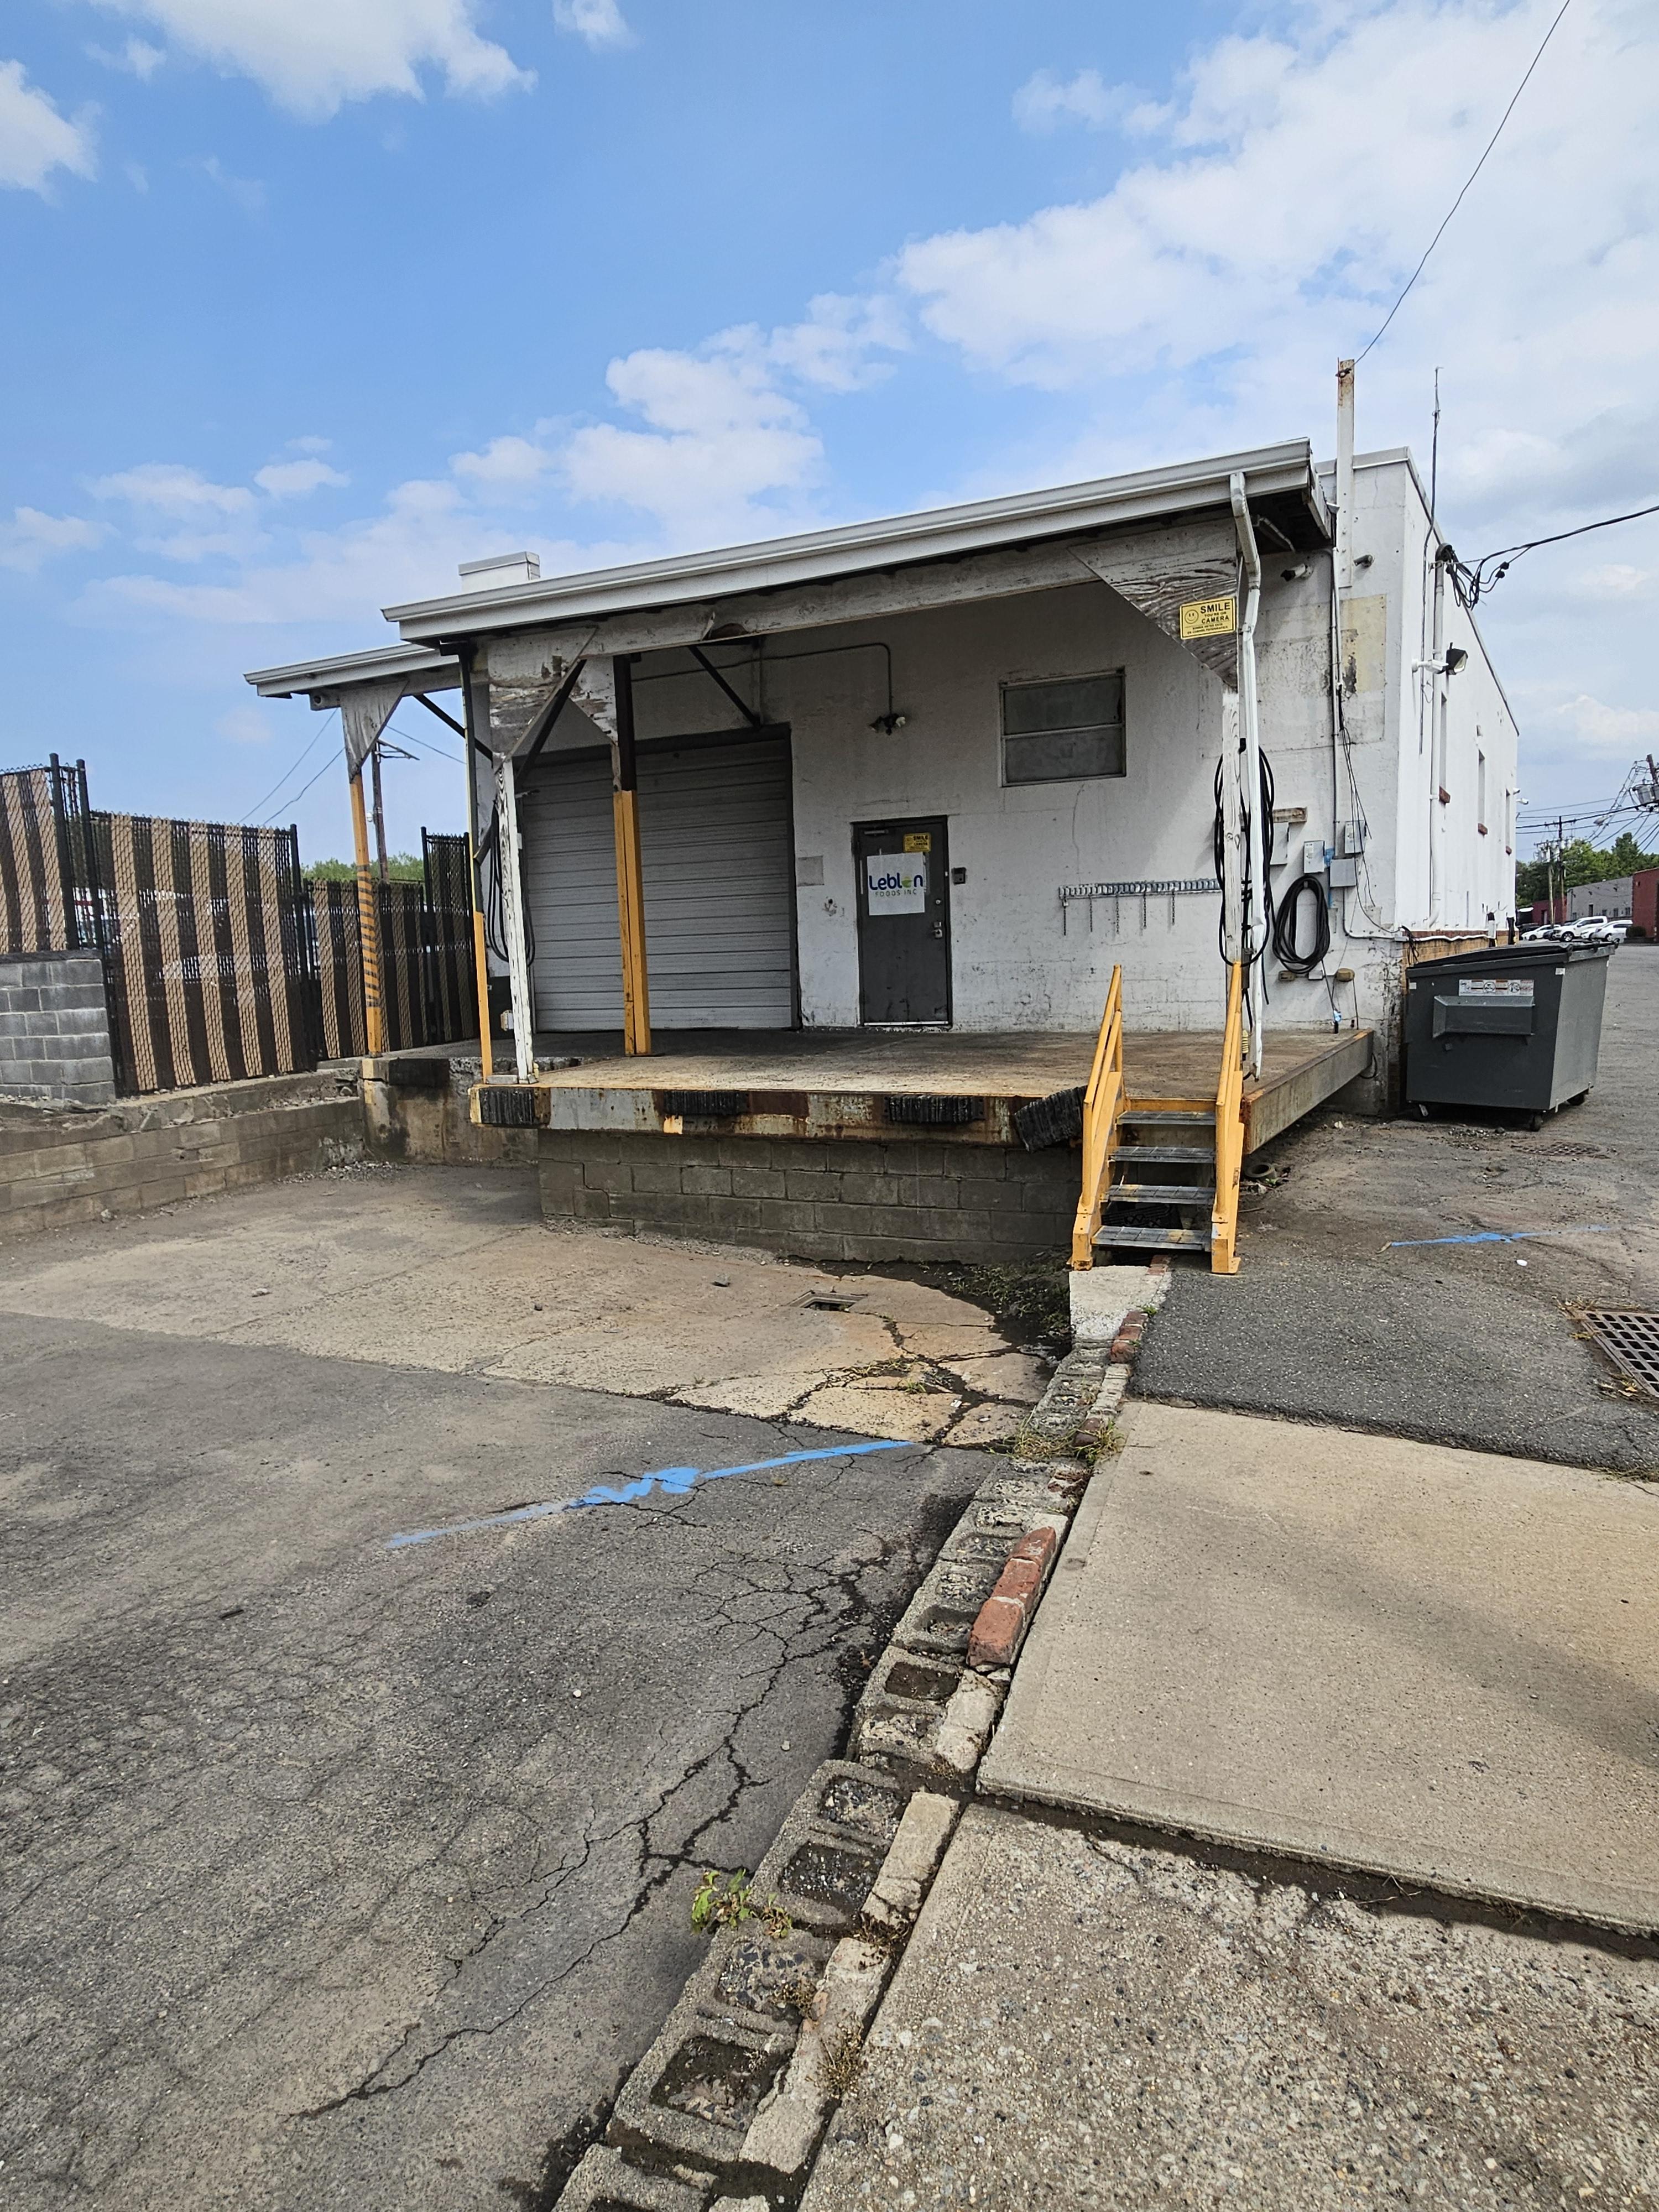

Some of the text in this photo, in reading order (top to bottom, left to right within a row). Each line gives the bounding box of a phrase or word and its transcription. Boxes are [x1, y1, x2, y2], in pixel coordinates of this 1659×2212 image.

[1201, 602, 1230, 613] SMILE
[1202, 615, 1229, 624] CAMERA
[869, 873, 923, 890] Leblon
